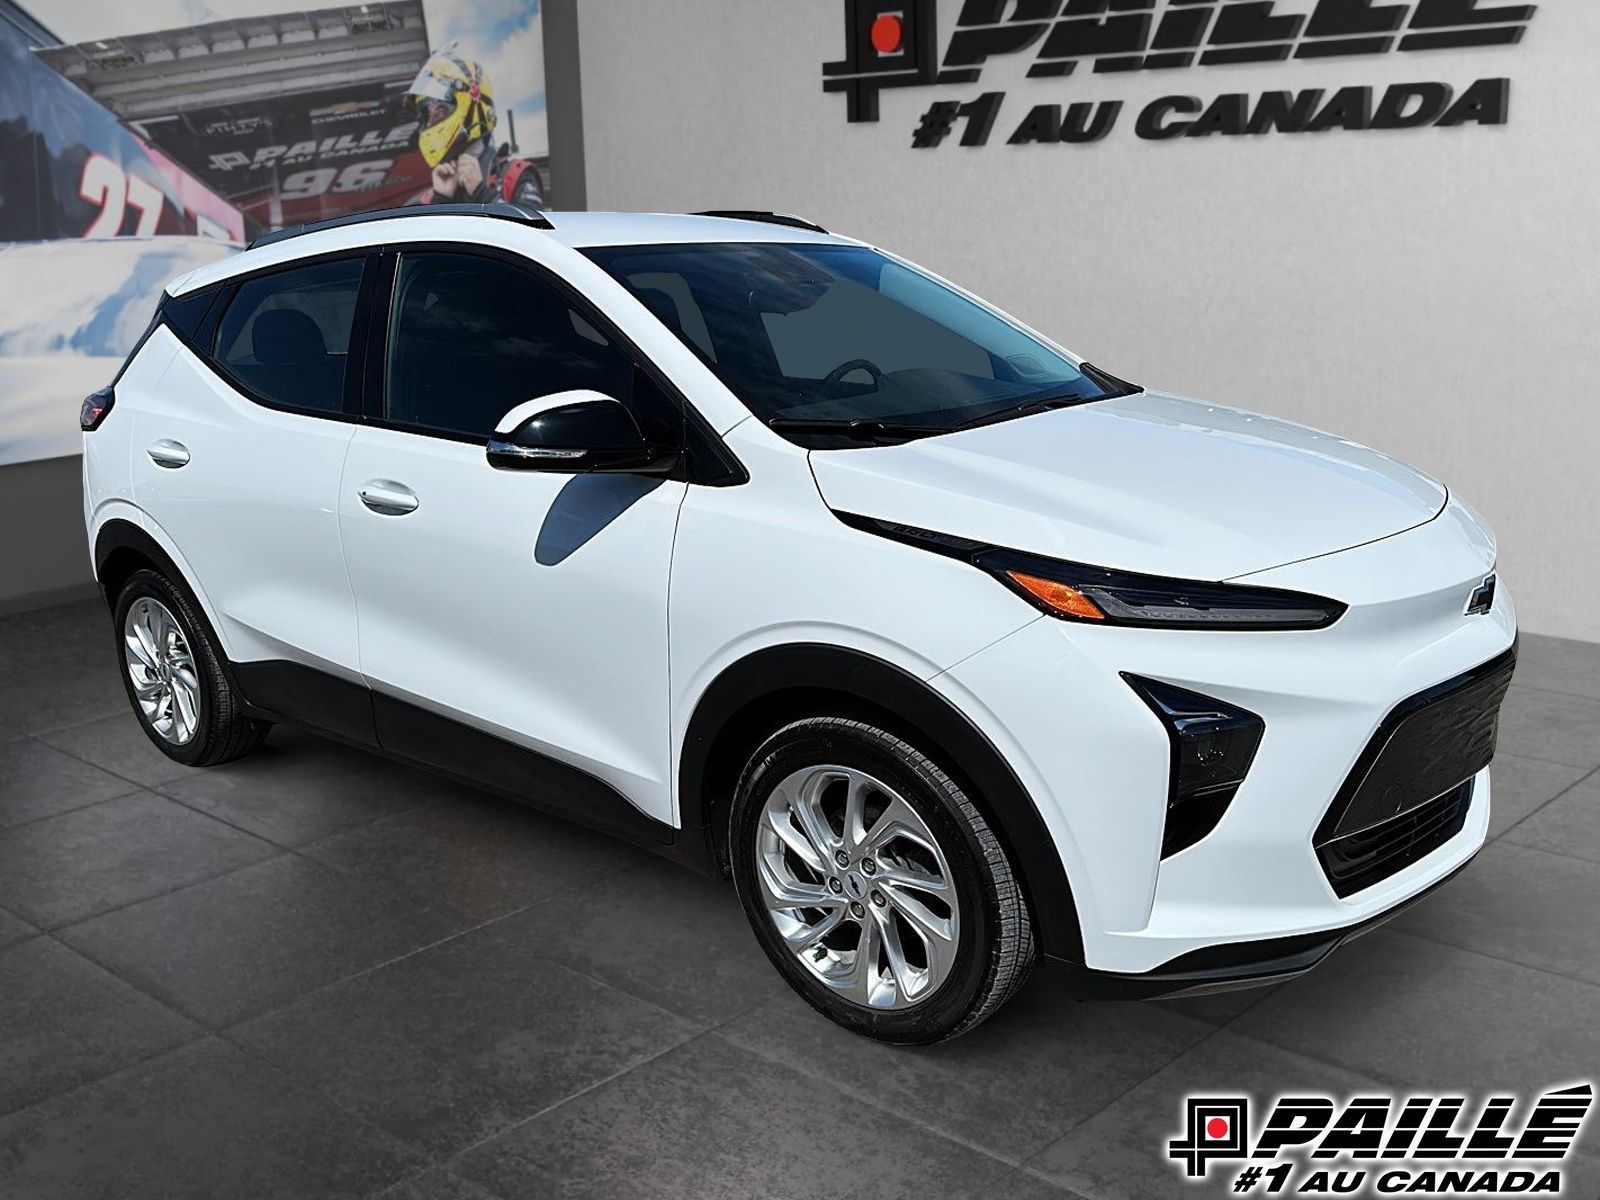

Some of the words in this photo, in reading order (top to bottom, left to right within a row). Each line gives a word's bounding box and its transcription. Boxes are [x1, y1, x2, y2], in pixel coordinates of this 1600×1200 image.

[911, 91, 1006, 149] #1
[1006, 100, 1123, 145] AU
[1134, 77, 1510, 140] CANADA
[320, 141, 409, 159] CANADA
[280, 159, 394, 199] 96
